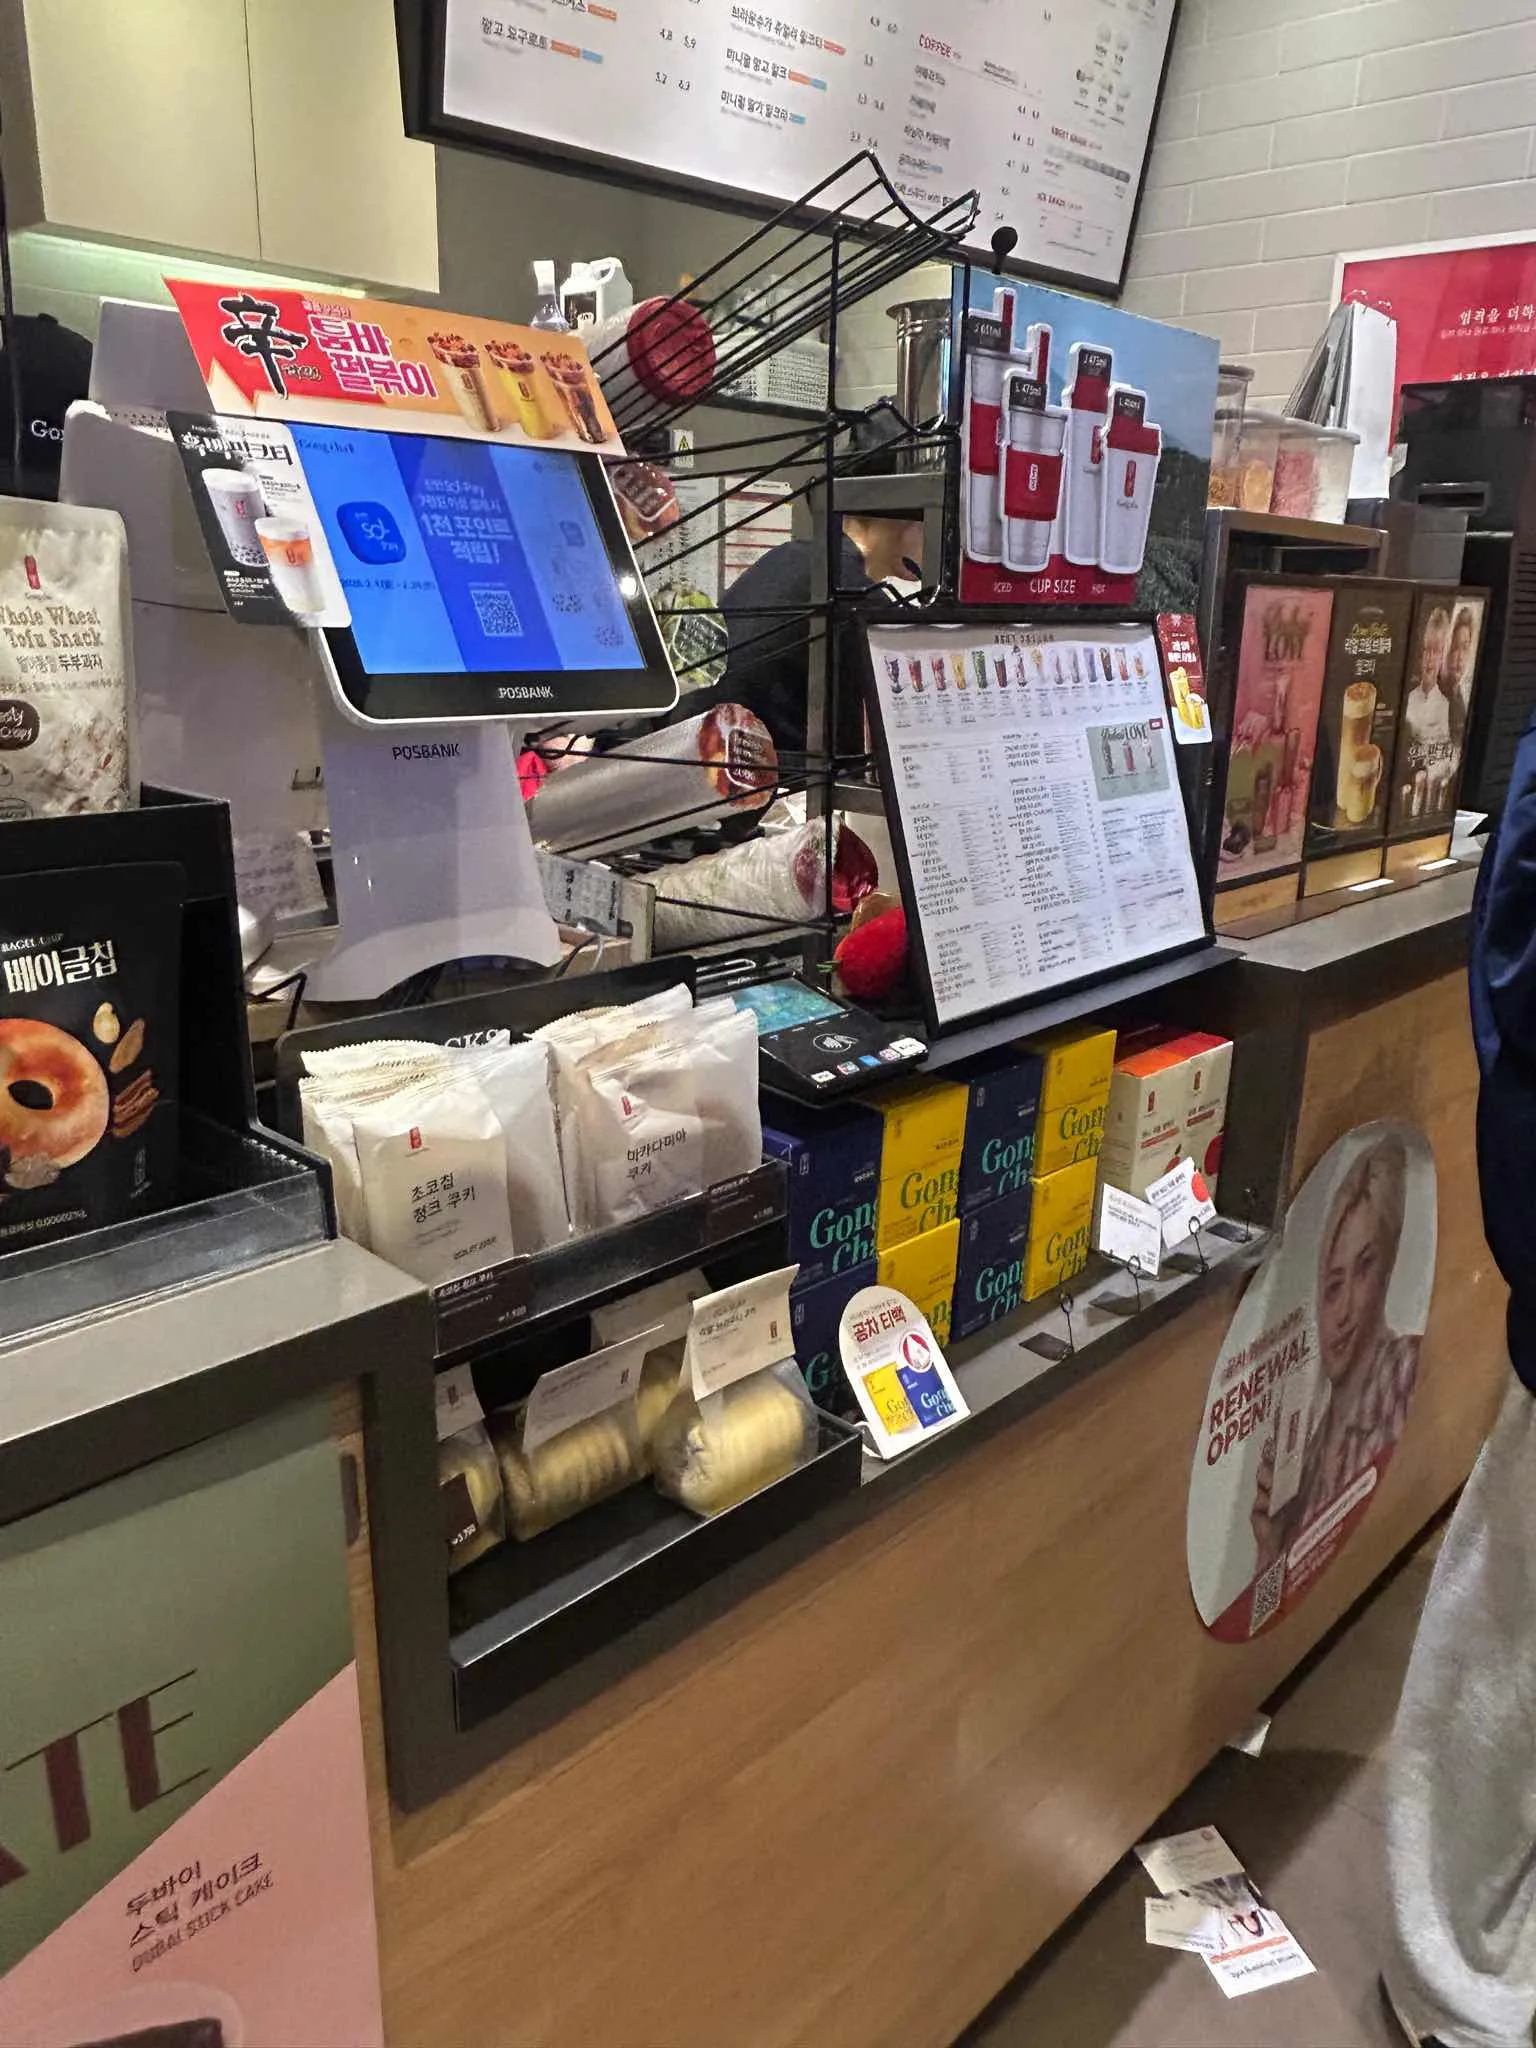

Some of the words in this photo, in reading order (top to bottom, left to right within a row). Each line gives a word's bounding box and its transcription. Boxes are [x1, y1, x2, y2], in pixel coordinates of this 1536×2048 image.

[219, 293, 308, 400] 辛
[308, 314, 392, 358] 툼바
[328, 350, 440, 399] 펄볶이
[1030, 578, 1051, 594] CUP
[1053, 579, 1077, 594] SIZE
[46, 603, 101, 625] Wheat
[3, 627, 48, 649] Tofu
[50, 626, 104, 649] Snack
[58, 653, 104, 672] 두부과자
[498, 686, 554, 700] POSBANK
[391, 742, 460, 761] POSBANK
[4, 939, 117, 993] 베이글칩
[626, 1127, 688, 1162] 마카다미아
[411, 1171, 454, 1203] 초코칩
[626, 1162, 652, 1181] 쿠키
[447, 1185, 476, 1209] 쿠키
[852, 1314, 880, 1344] 공차
[880, 1305, 907, 1330] 티백
[1209, 1330, 1311, 1435] RENEWAL
[126, 1859, 201, 1917] 두바이
[129, 1901, 179, 1949] 스틱
[191, 1851, 263, 1909] 케이크
[234, 1869, 274, 1907] CAKE
